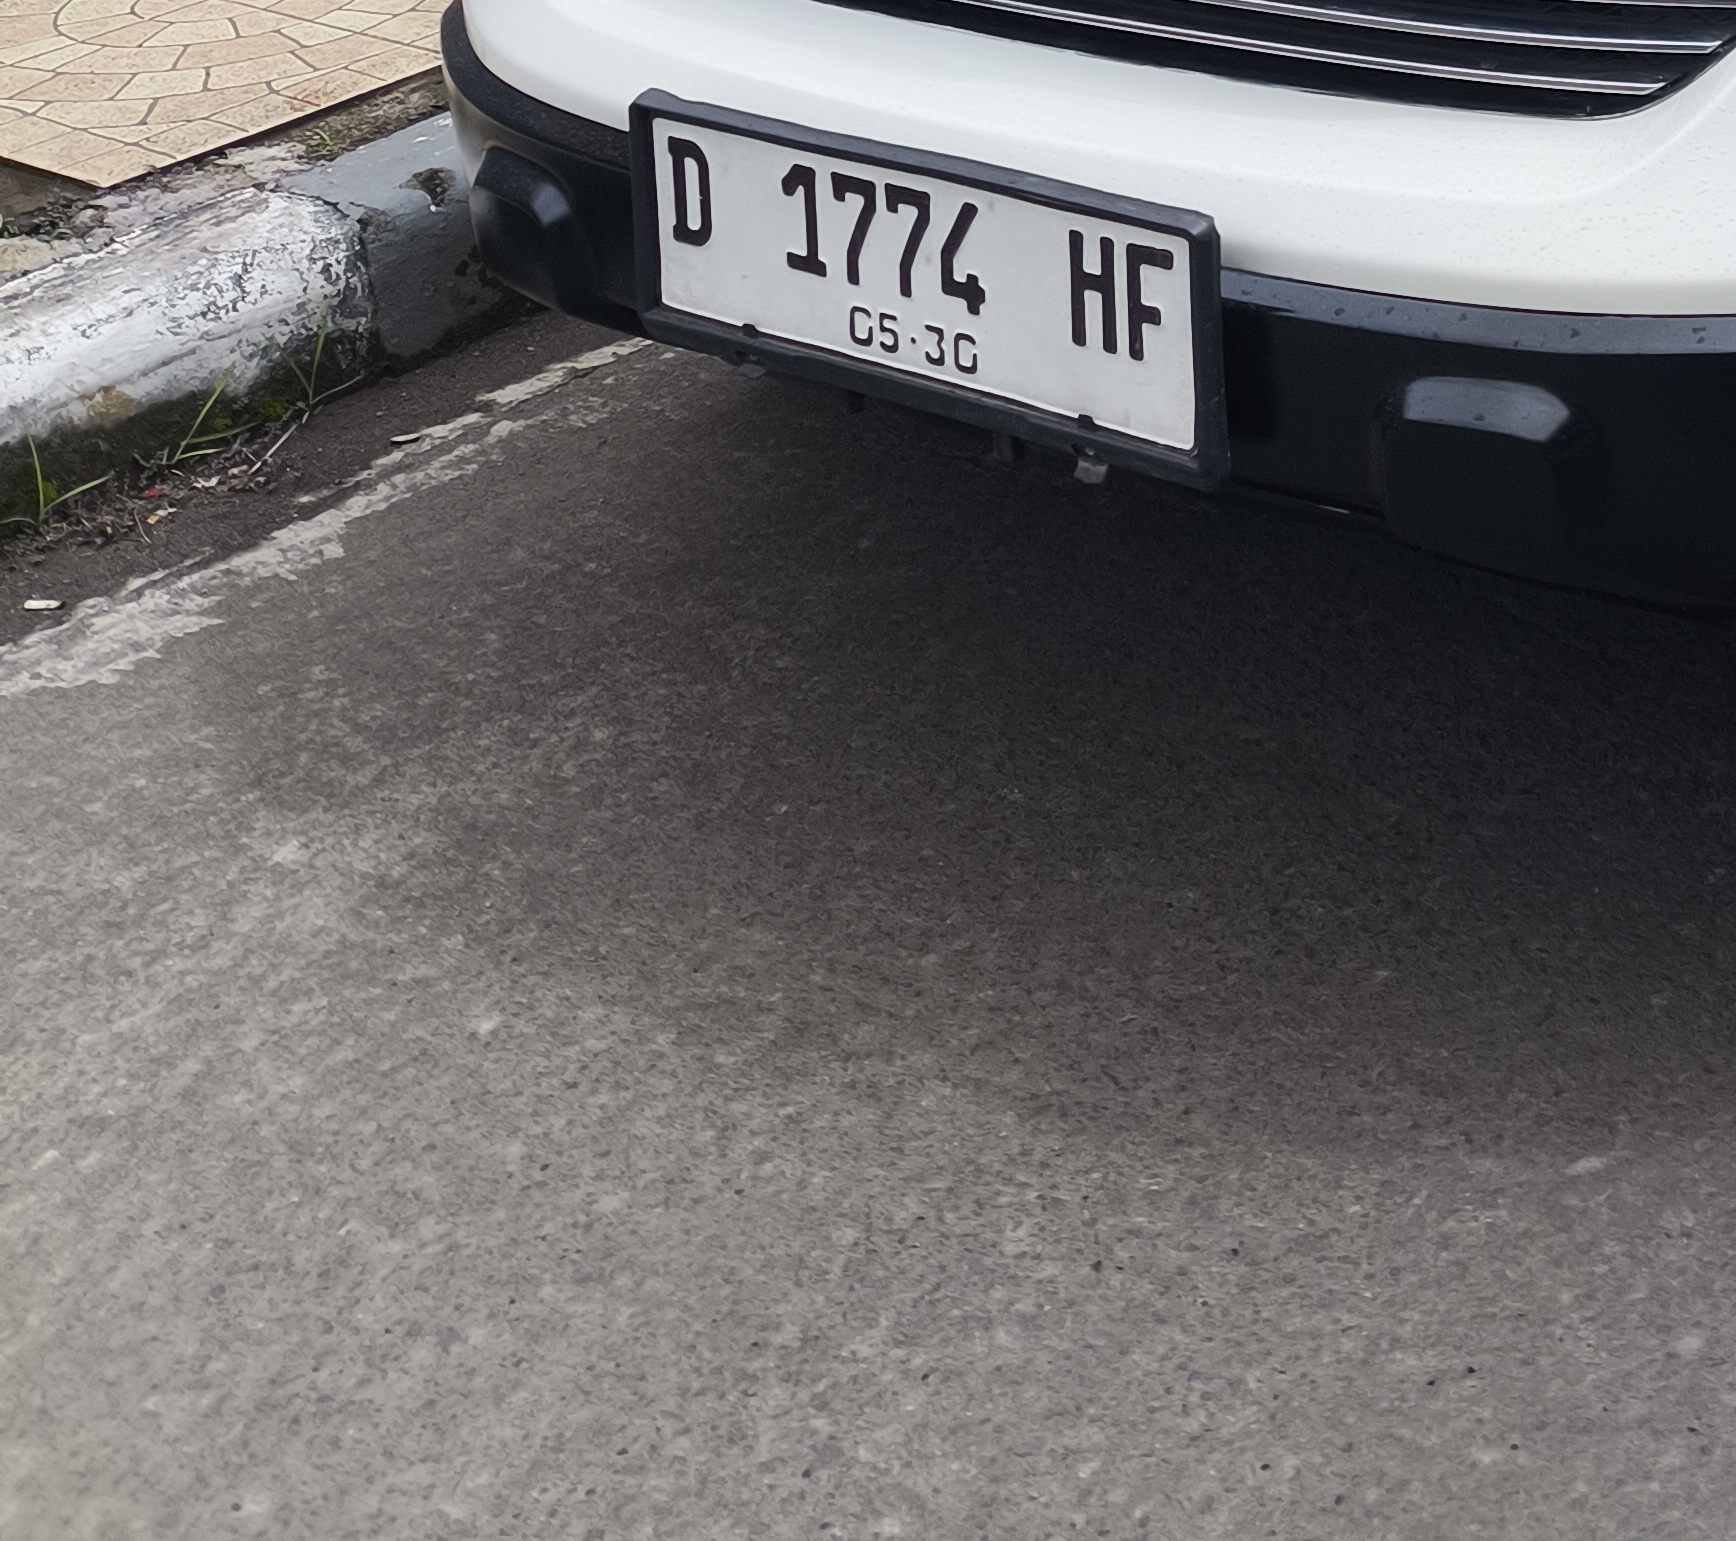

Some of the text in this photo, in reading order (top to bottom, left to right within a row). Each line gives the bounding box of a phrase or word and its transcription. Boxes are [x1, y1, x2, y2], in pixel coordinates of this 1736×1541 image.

[667, 135, 1174, 362] D 1774 HF
